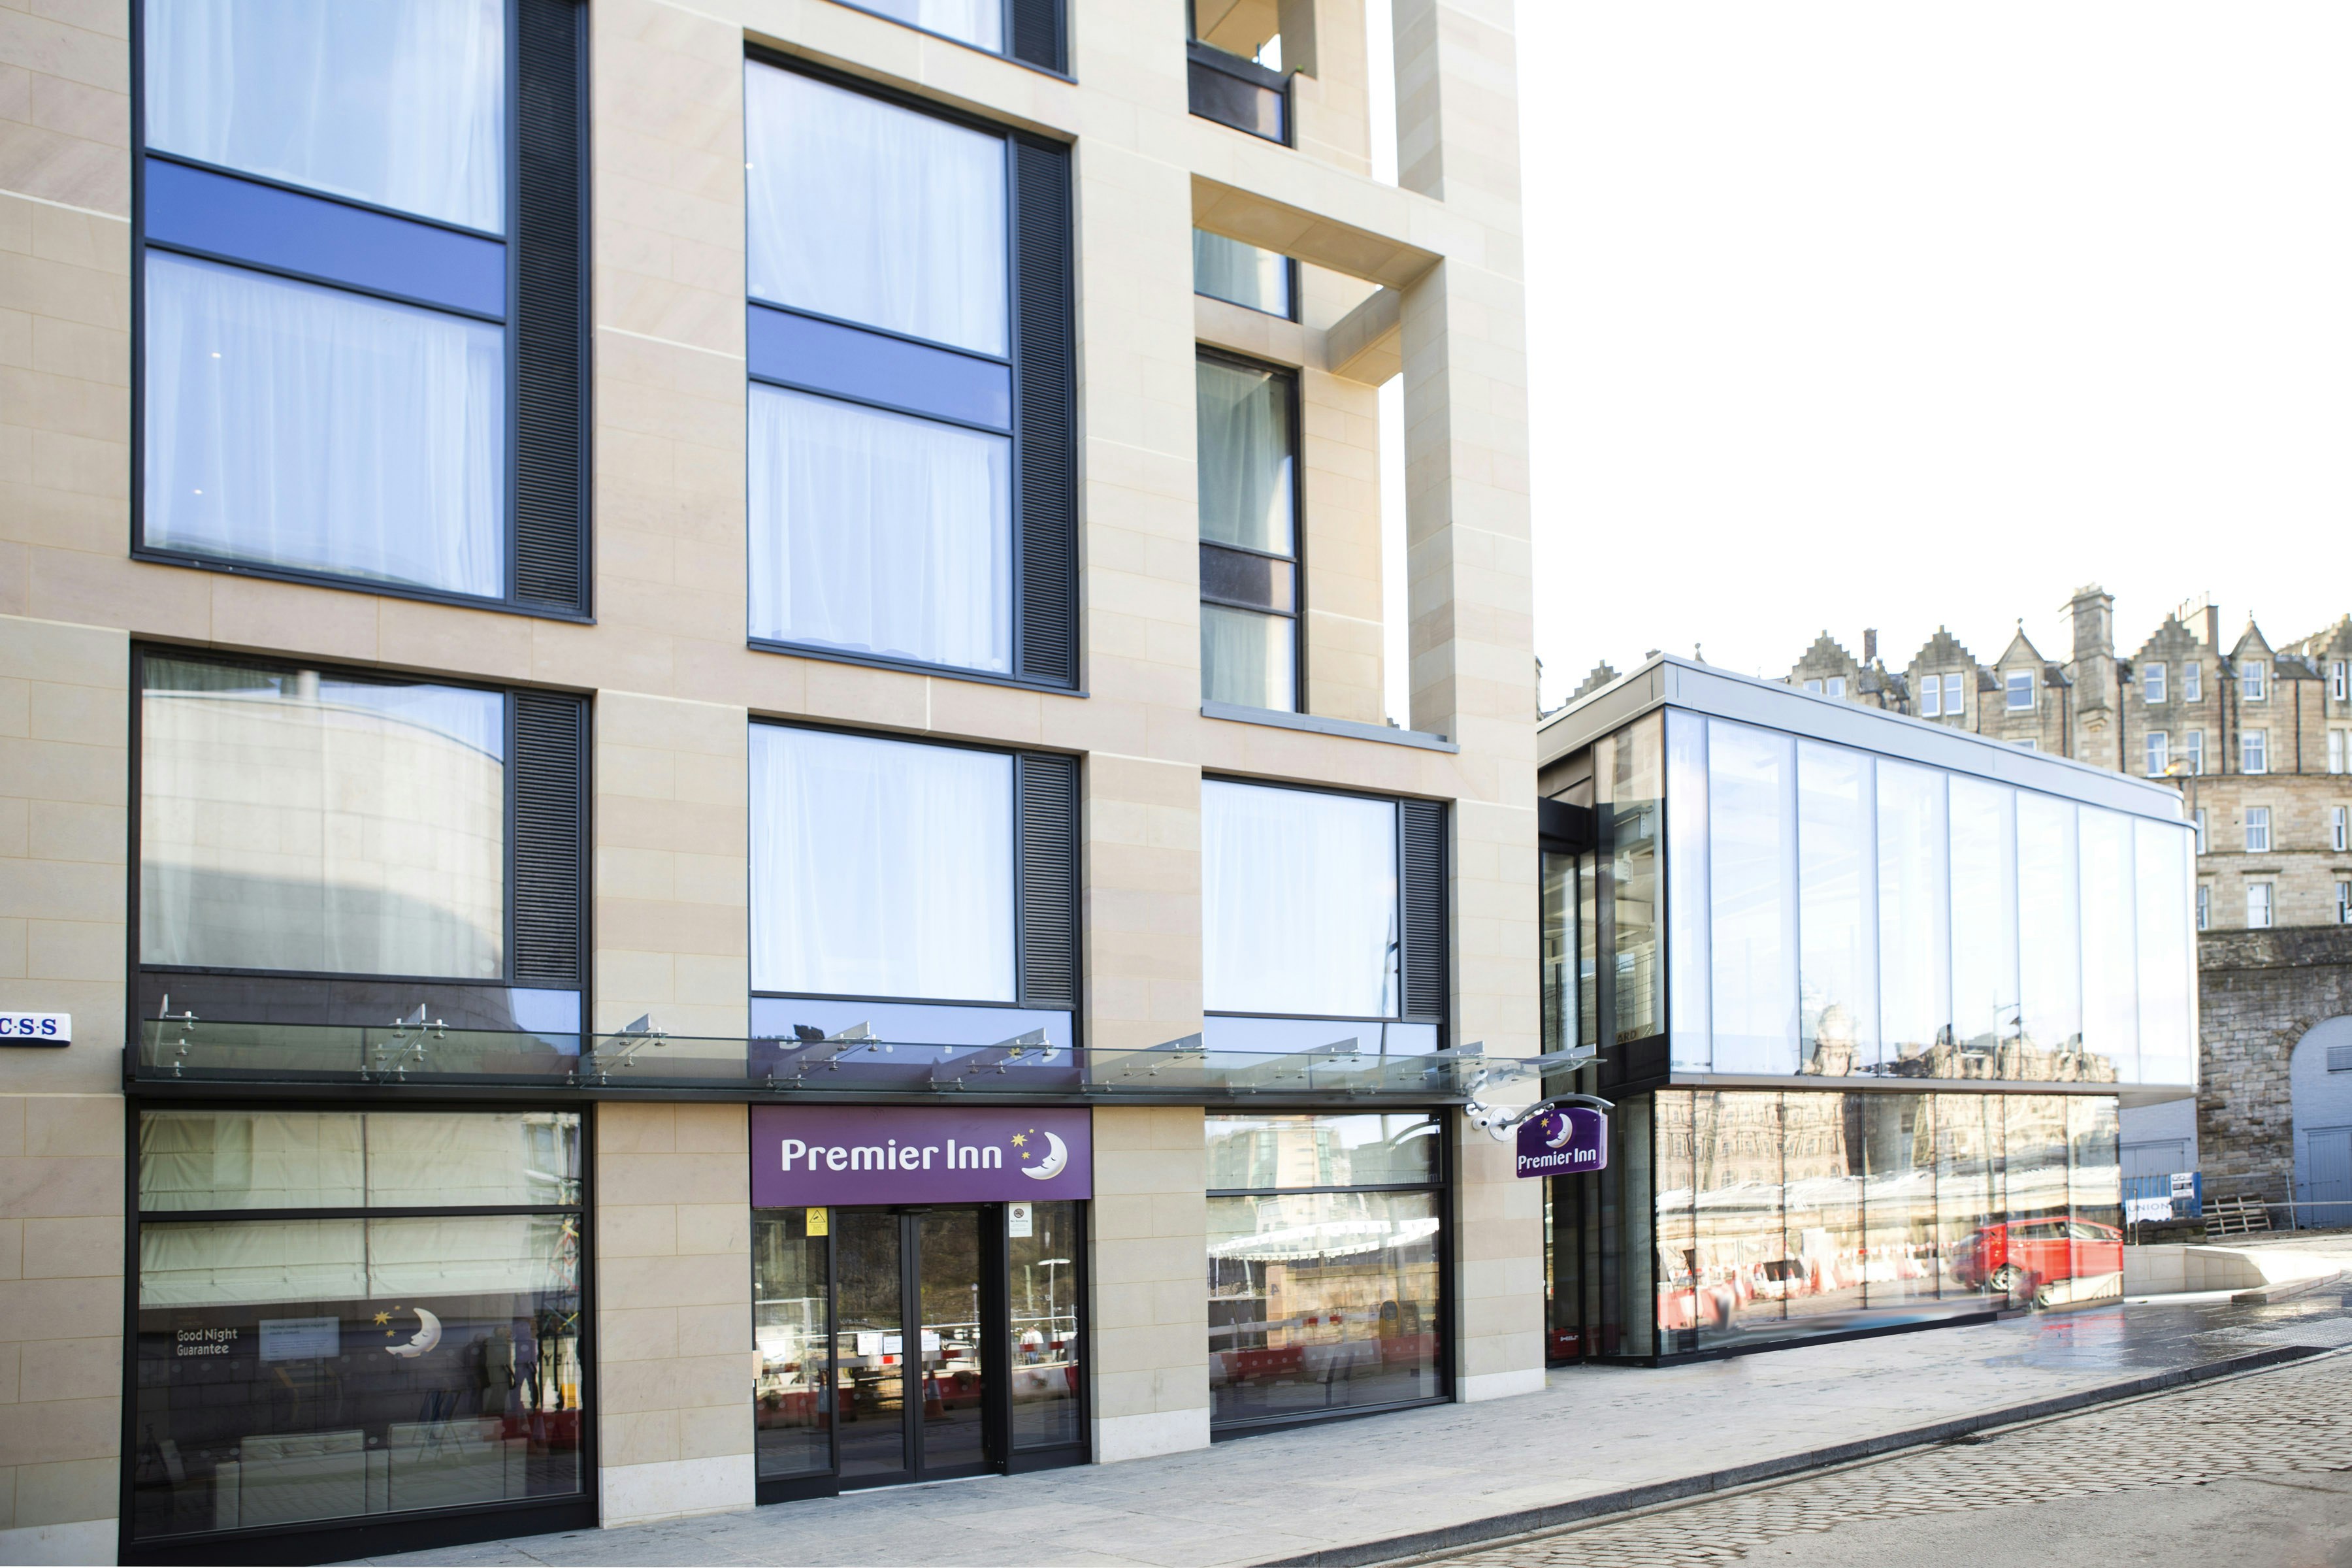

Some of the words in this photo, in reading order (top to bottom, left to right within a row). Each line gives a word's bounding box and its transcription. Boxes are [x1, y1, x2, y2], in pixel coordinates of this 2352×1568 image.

[782, 1139, 939, 1171] Premier
[947, 1139, 1002, 1169] Inn
[1518, 1151, 1573, 1170] Premier
[1575, 1148, 1596, 1163] Inn
[2128, 1203, 2169, 1212] UNION
[177, 1329, 203, 1341] Good
[205, 1328, 238, 1343] Night
[177, 1344, 229, 1356] Guarantee
